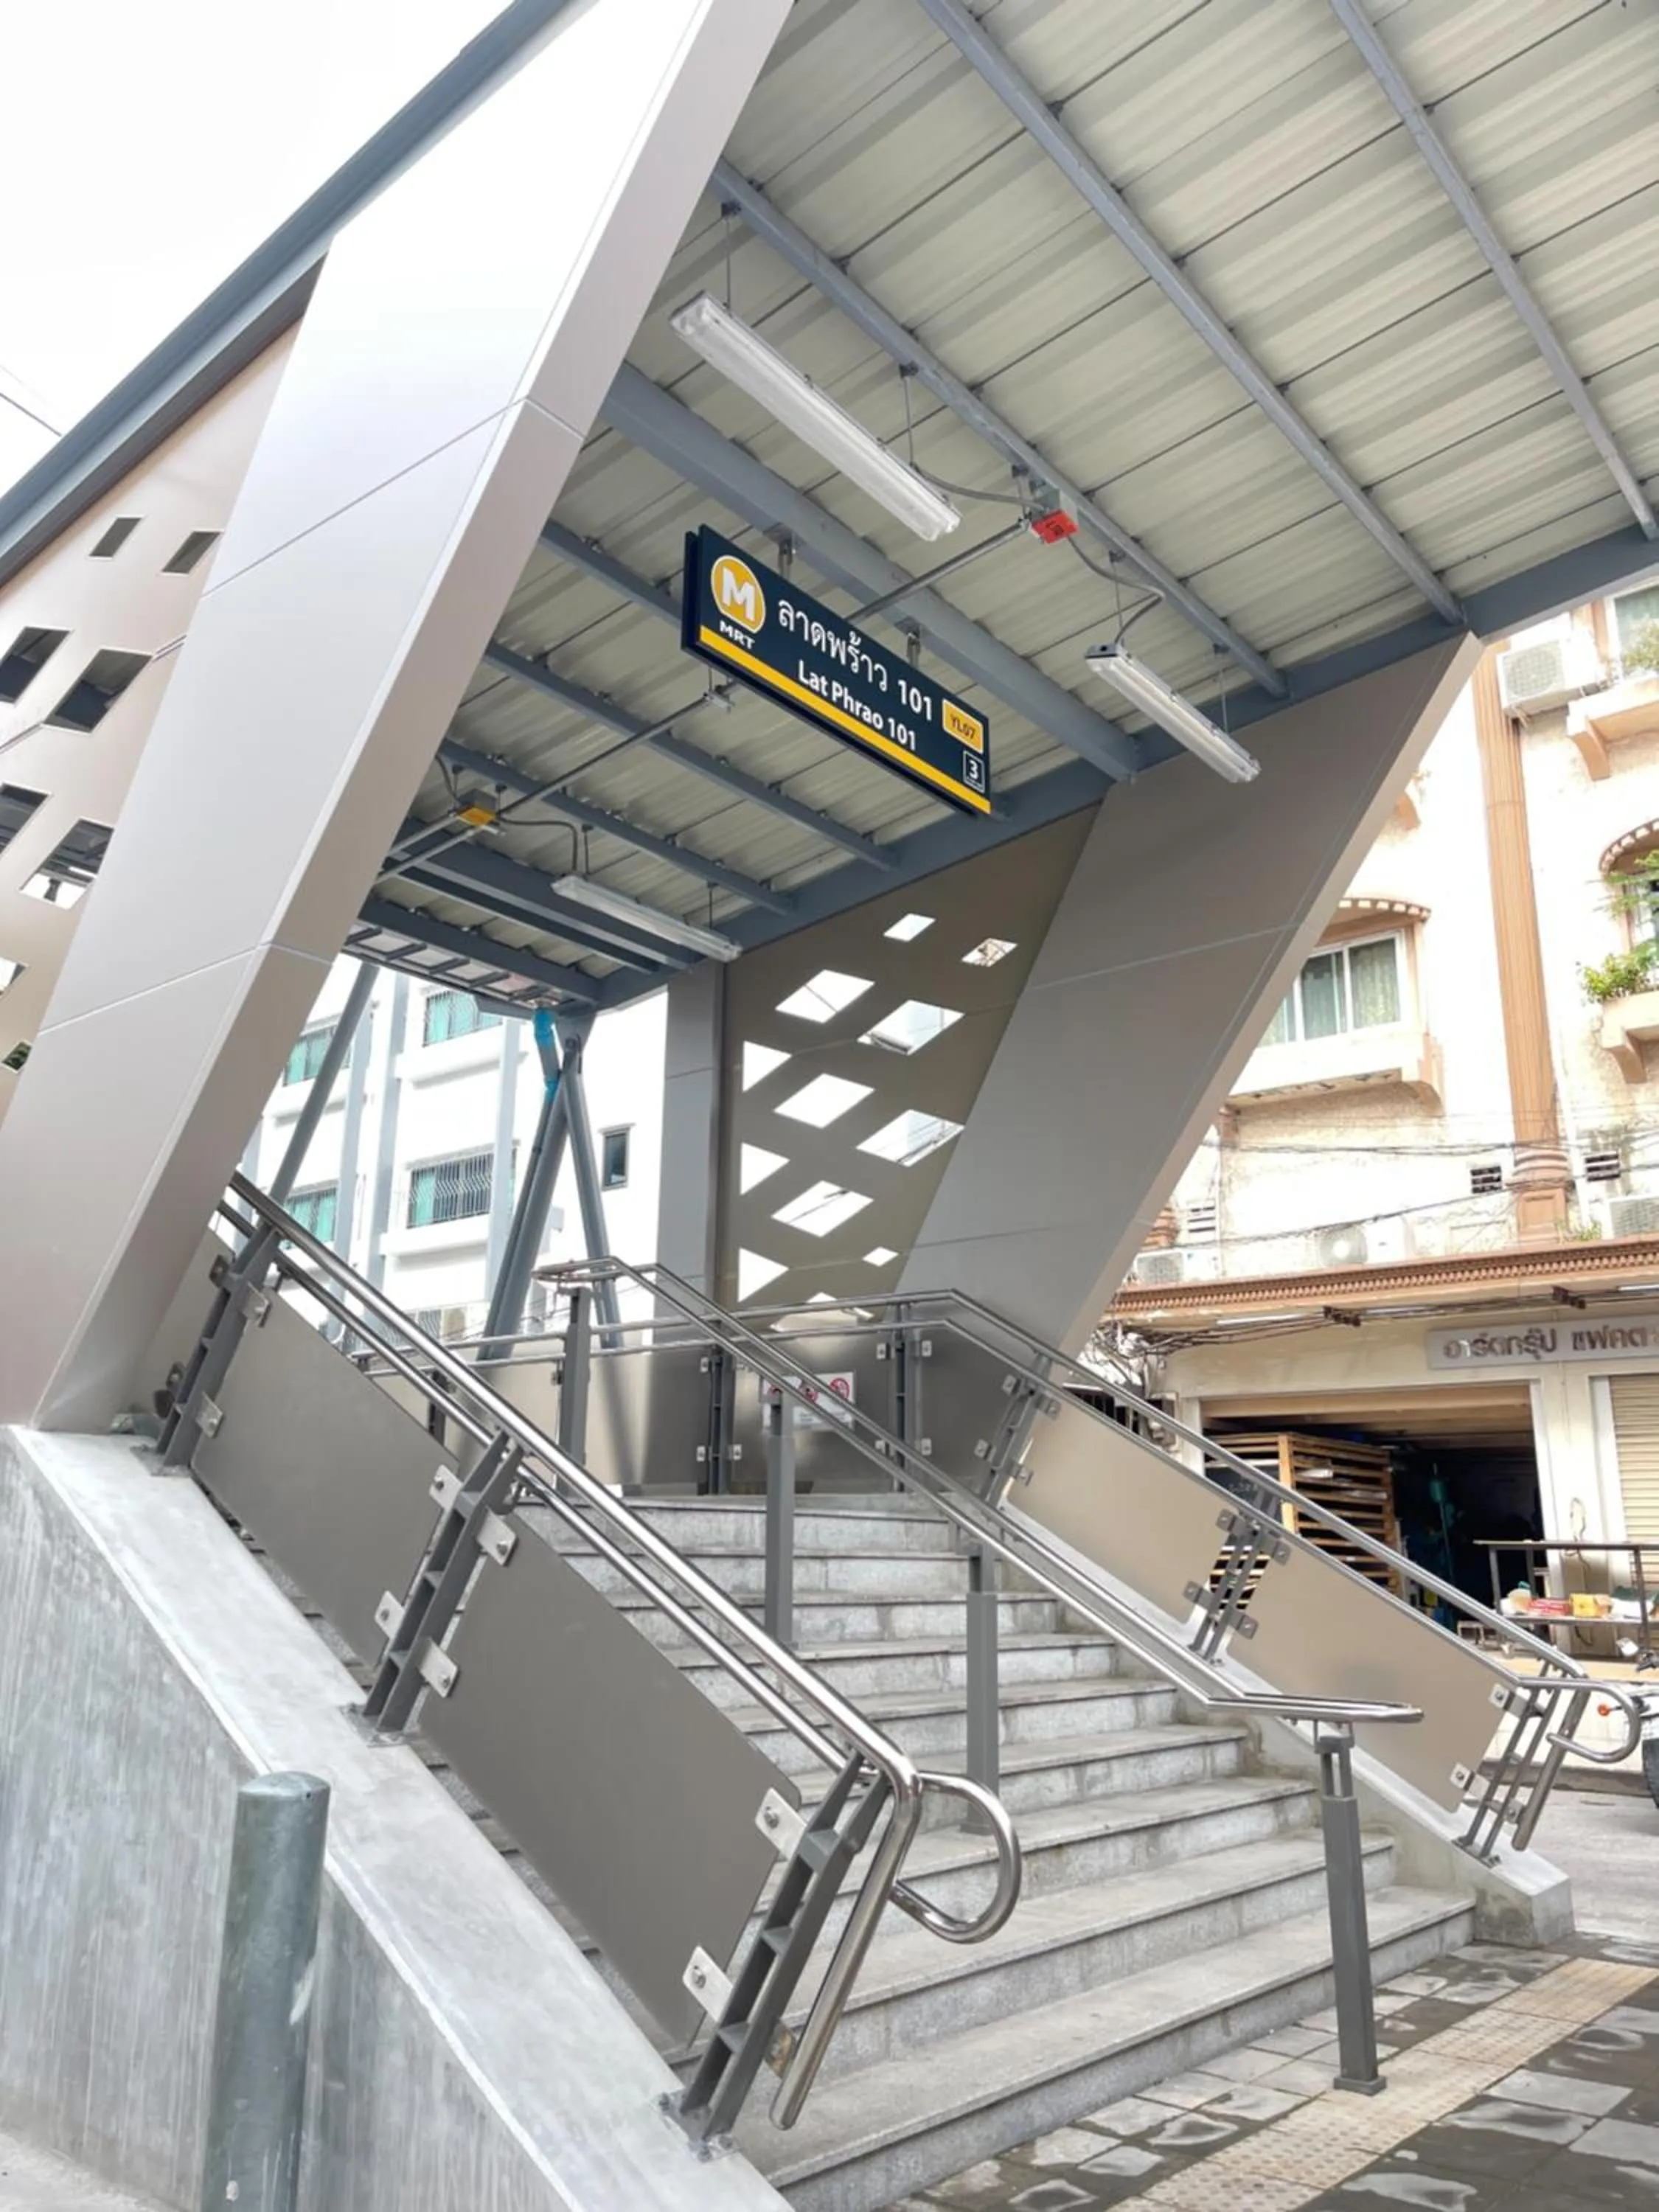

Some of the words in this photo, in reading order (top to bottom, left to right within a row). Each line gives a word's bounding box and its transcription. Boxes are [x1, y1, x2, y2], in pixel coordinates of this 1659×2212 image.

[722, 566, 756, 622] M
[719, 620, 756, 650] MRT
[778, 599, 888, 692] ลาดพร้าว
[897, 679, 932, 721] 101
[798, 659, 830, 696] Lat
[831, 683, 885, 729] Phrao
[887, 717, 917, 751] 101
[968, 759, 980, 780] 3
[1571, 1324, 1659, 1351] แฟคต
